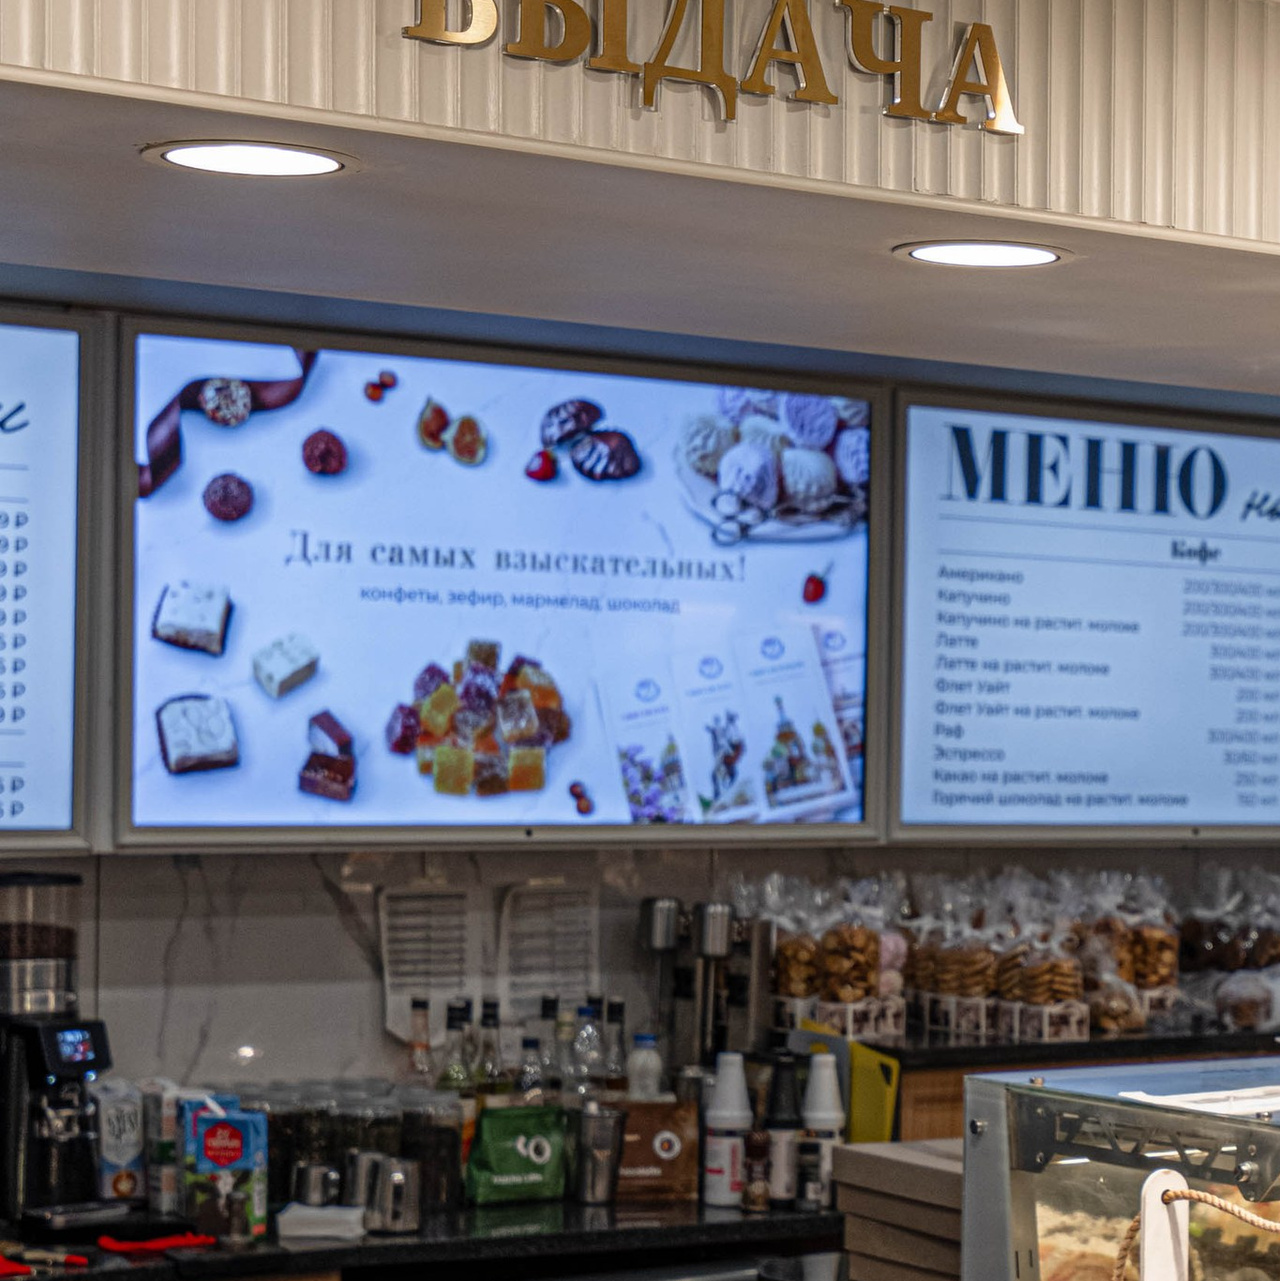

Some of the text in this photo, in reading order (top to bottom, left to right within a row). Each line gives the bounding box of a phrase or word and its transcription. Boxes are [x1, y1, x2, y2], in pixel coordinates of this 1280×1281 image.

[940, 424, 1229, 520] МЕНЮ
[285, 530, 747, 582] Для самых взыскательных!
[1171, 539, 1221, 565] Кофе
[607, 598, 680, 615] шоколад
